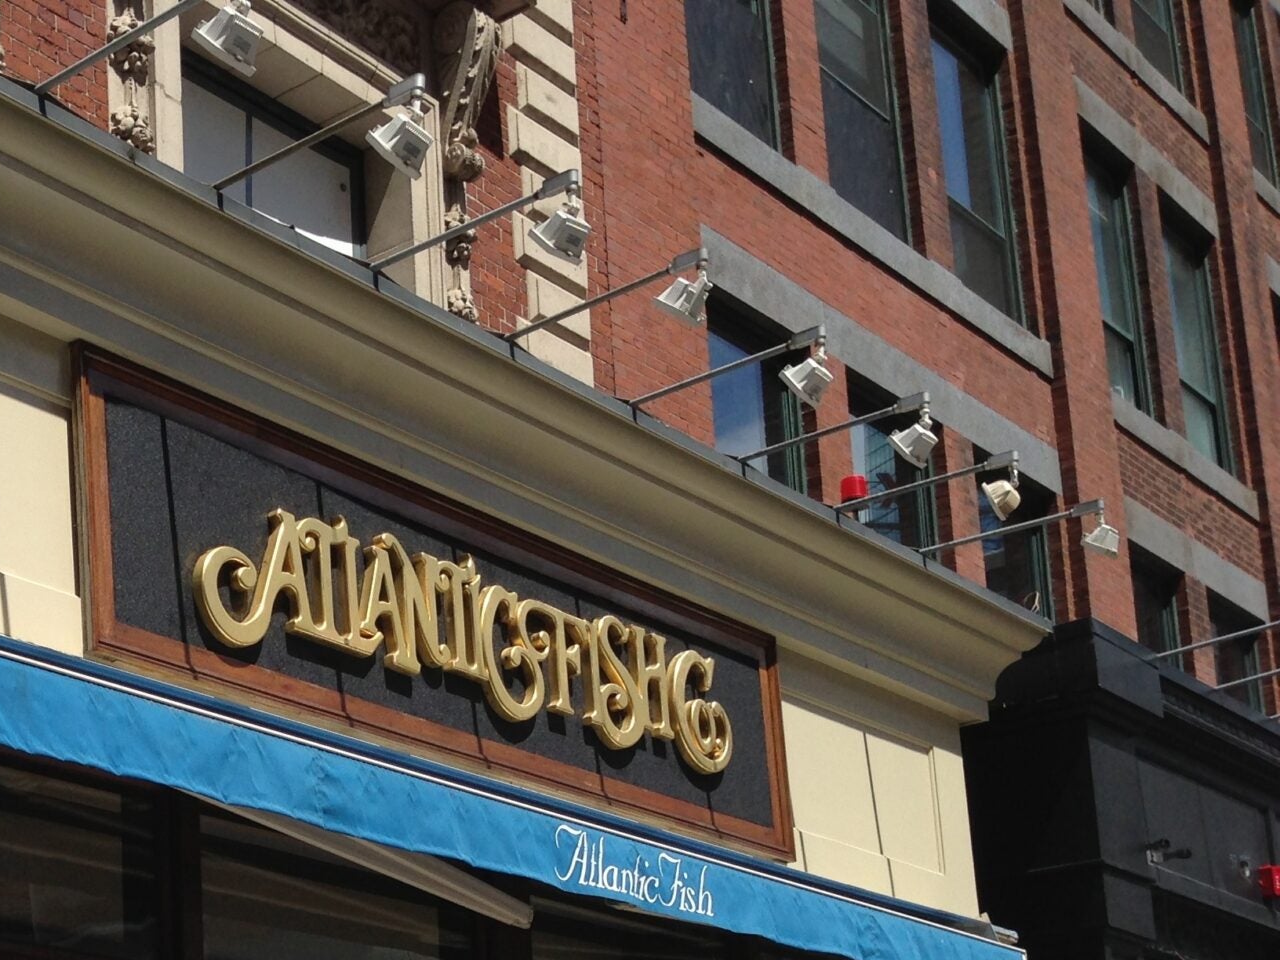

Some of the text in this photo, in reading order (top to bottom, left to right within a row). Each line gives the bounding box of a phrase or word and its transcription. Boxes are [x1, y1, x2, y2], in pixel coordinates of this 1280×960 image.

[192, 508, 545, 722] ATLANTIC
[518, 597, 675, 750] FISH
[554, 824, 714, 917] Atlantic Fish
